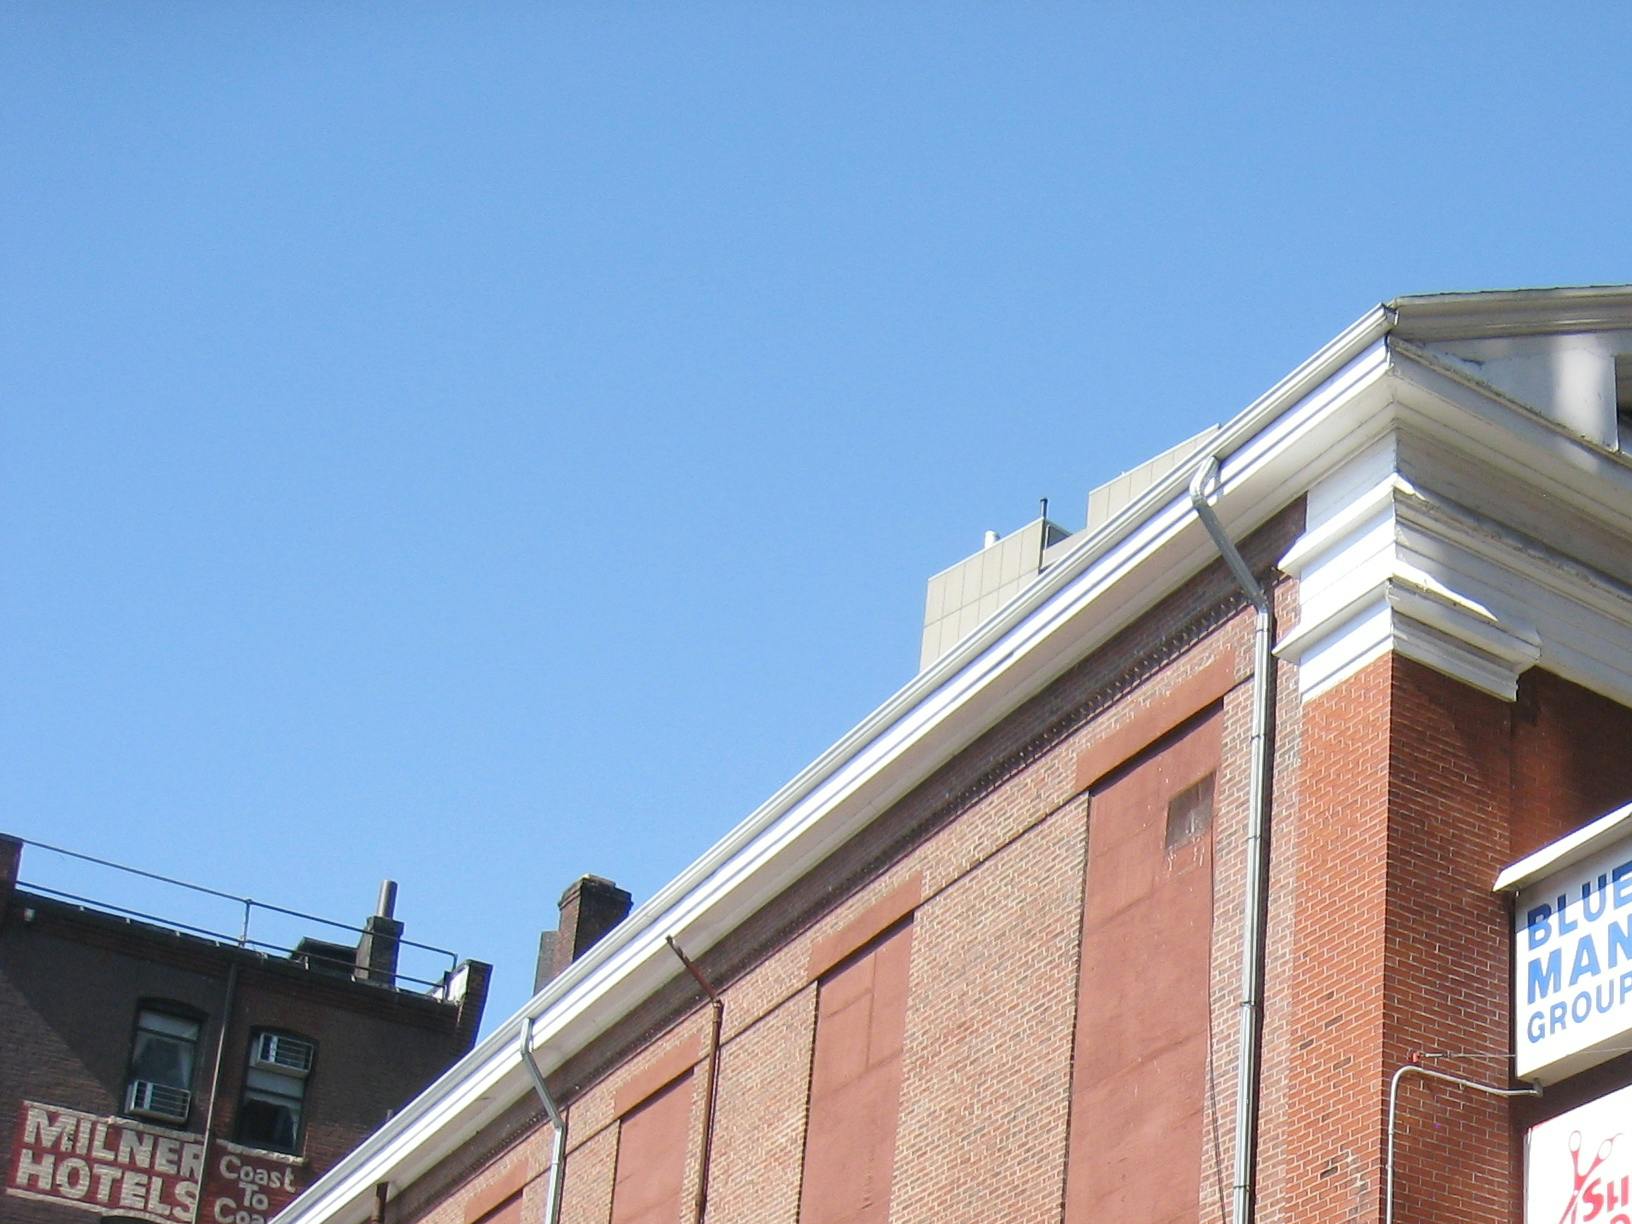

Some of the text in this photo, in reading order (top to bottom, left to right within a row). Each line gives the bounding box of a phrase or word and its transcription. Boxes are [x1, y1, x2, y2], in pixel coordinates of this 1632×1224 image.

[24, 1106, 203, 1182] MILNER
[16, 1148, 200, 1222] HOTELS
[219, 1154, 296, 1193] Coast
[238, 1182, 269, 1210] To
